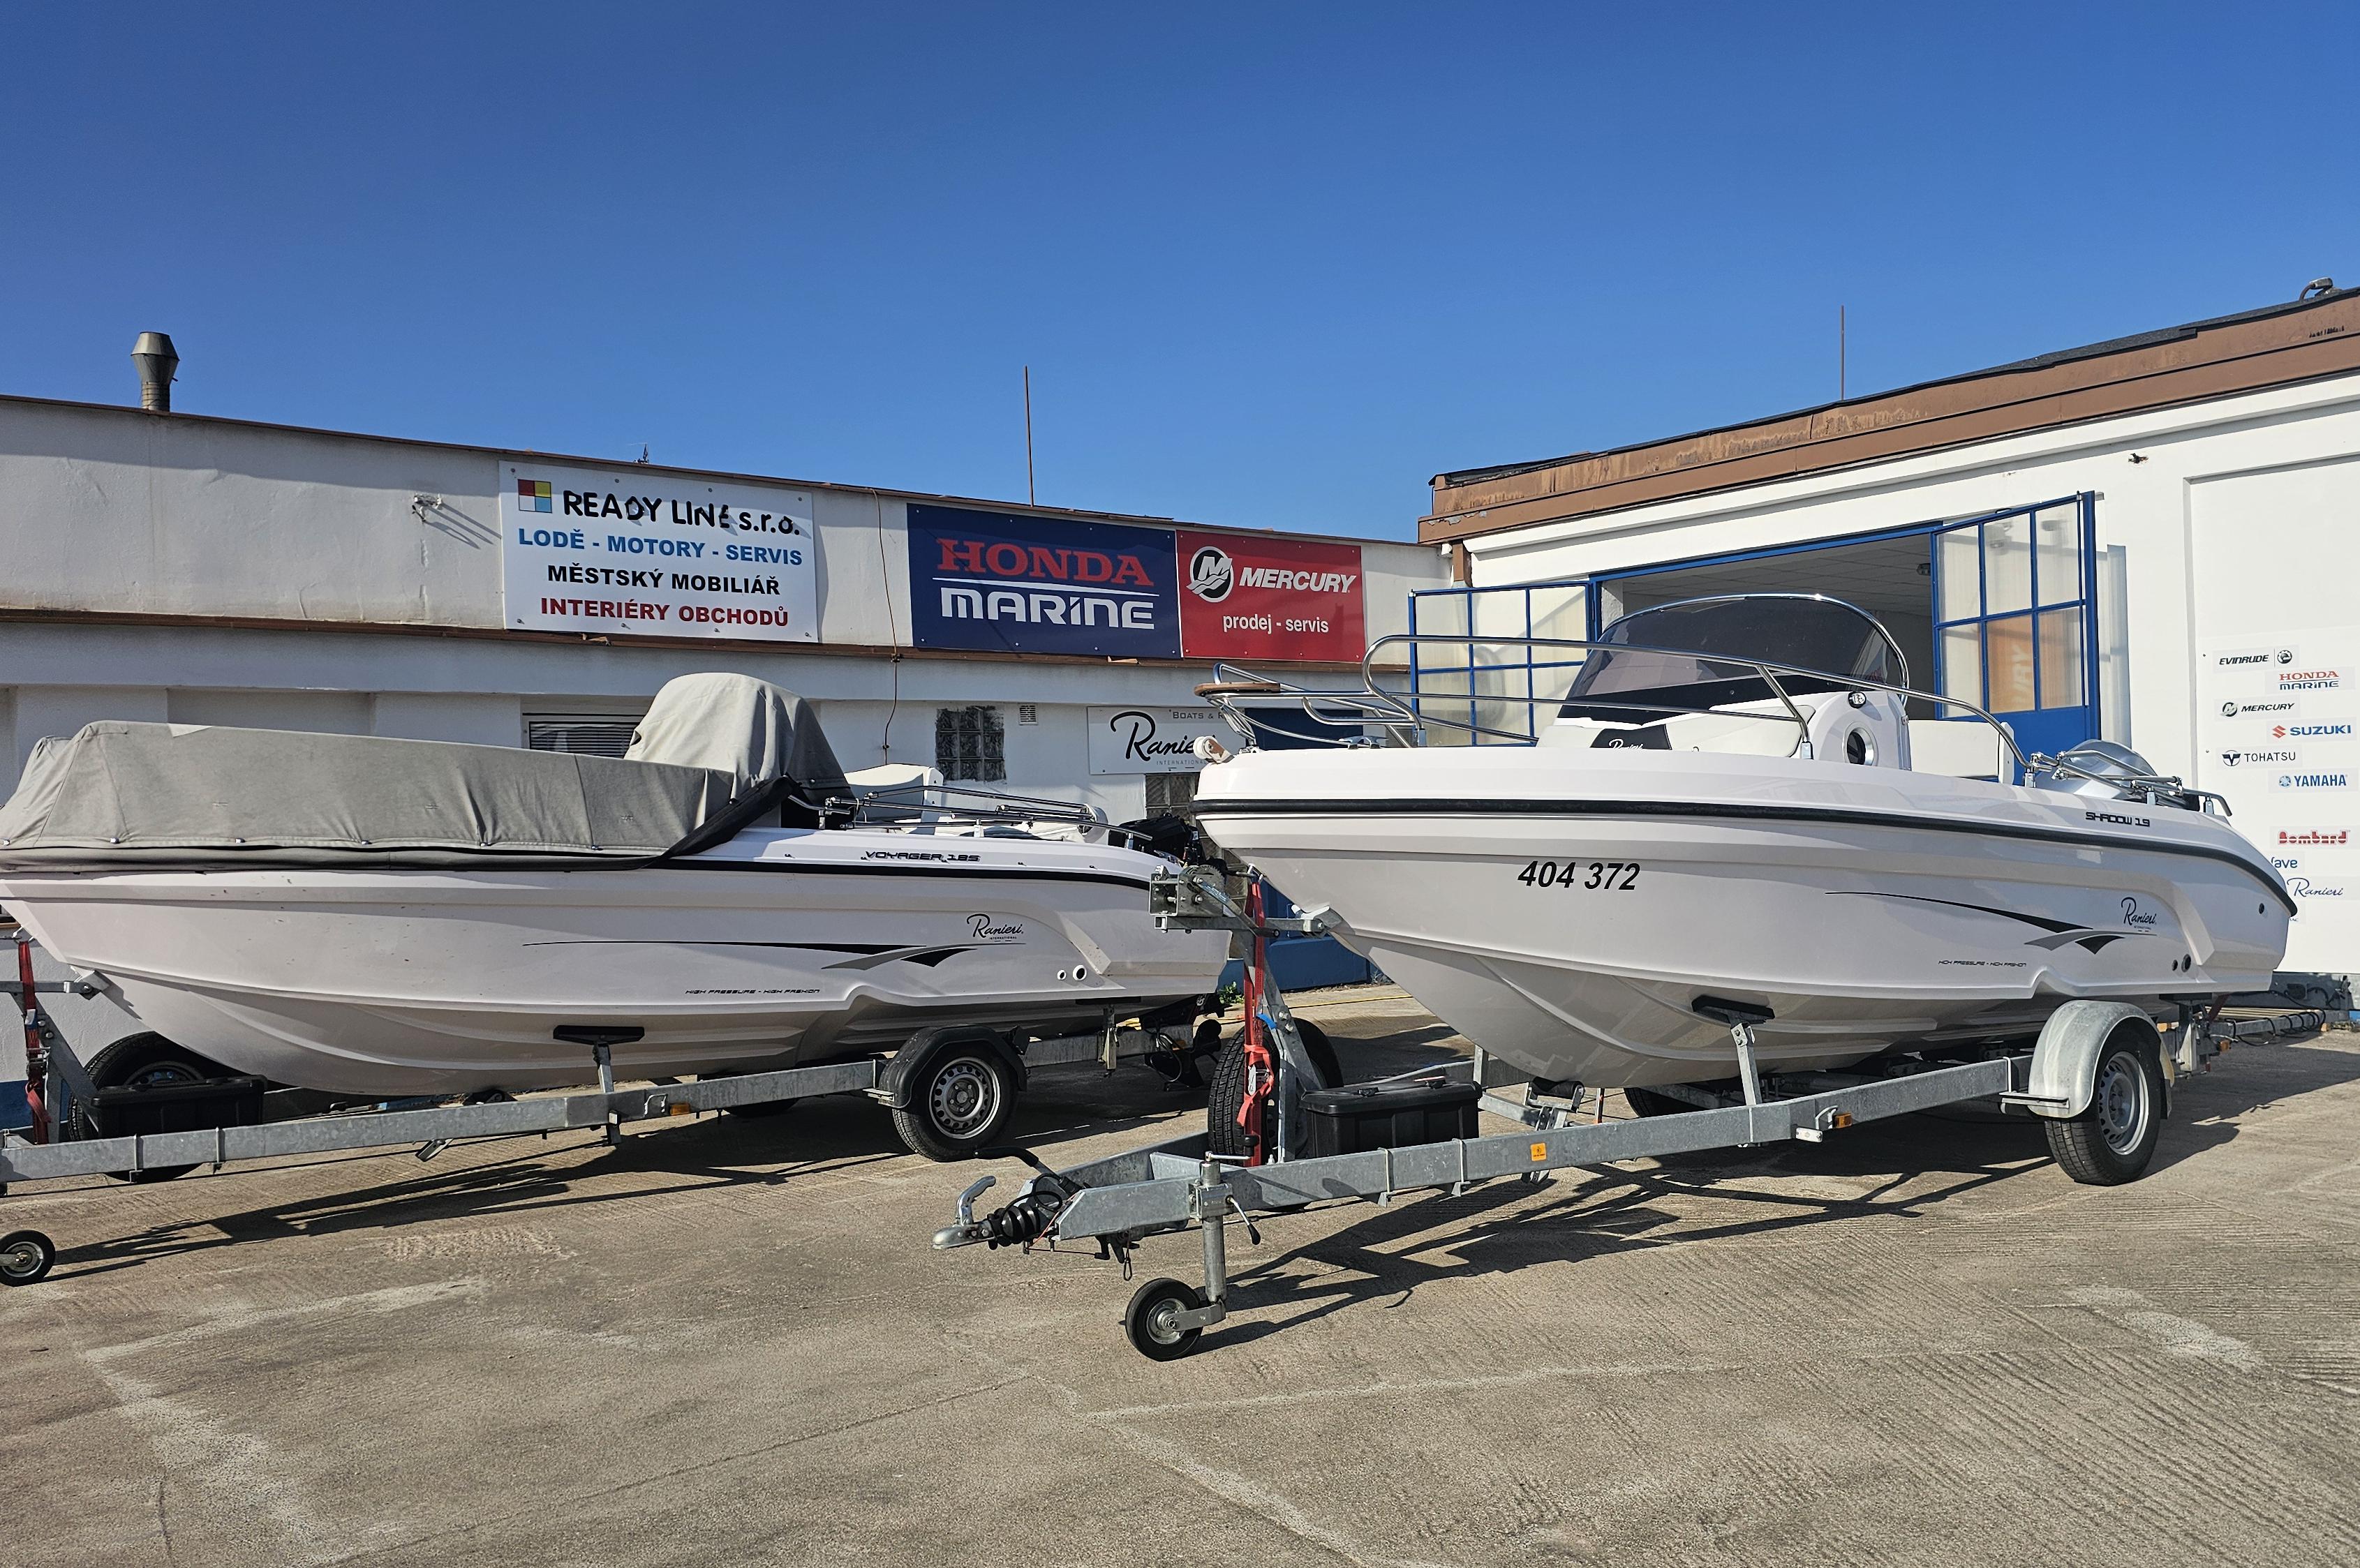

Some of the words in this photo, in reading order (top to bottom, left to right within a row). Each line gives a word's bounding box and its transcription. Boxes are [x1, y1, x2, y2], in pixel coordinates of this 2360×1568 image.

[563, 490, 662, 522] READY
[739, 512, 801, 535] s.r.o.
[519, 528, 585, 550] LODĚ
[607, 536, 706, 558] MOTORY
[726, 545, 803, 566] SERVIS
[936, 537, 1155, 587] HONDA
[548, 562, 664, 588] MĚSTSKÝ
[671, 574, 780, 595] MOBILIÁŘ
[1239, 567, 1356, 593] MERCURY
[541, 597, 670, 620] INTERIÉRY
[678, 606, 789, 627] OBCHODŮ
[1223, 614, 1272, 634] prodej
[1286, 617, 1329, 634] servis
[2219, 655, 2269, 665] EVINRUDE
[2279, 671, 2339, 680] HONDA
[2241, 703, 2295, 712] MERCURY
[2290, 725, 2352, 736] SUZUKI
[2244, 752, 2296, 763] TOHATSU
[2294, 775, 2347, 787] YAMAHA
[2086, 812, 2132, 825] SHADOW
[2135, 818, 2150, 827] 19
[2278, 830, 2347, 844] Bombard
[866, 851, 942, 861] VOYAGER
[1517, 860, 1576, 888] 404
[1584, 862, 1640, 890] 372
[2287, 877, 2344, 897] Ranieri
[2121, 897, 2157, 926] Ranieri
